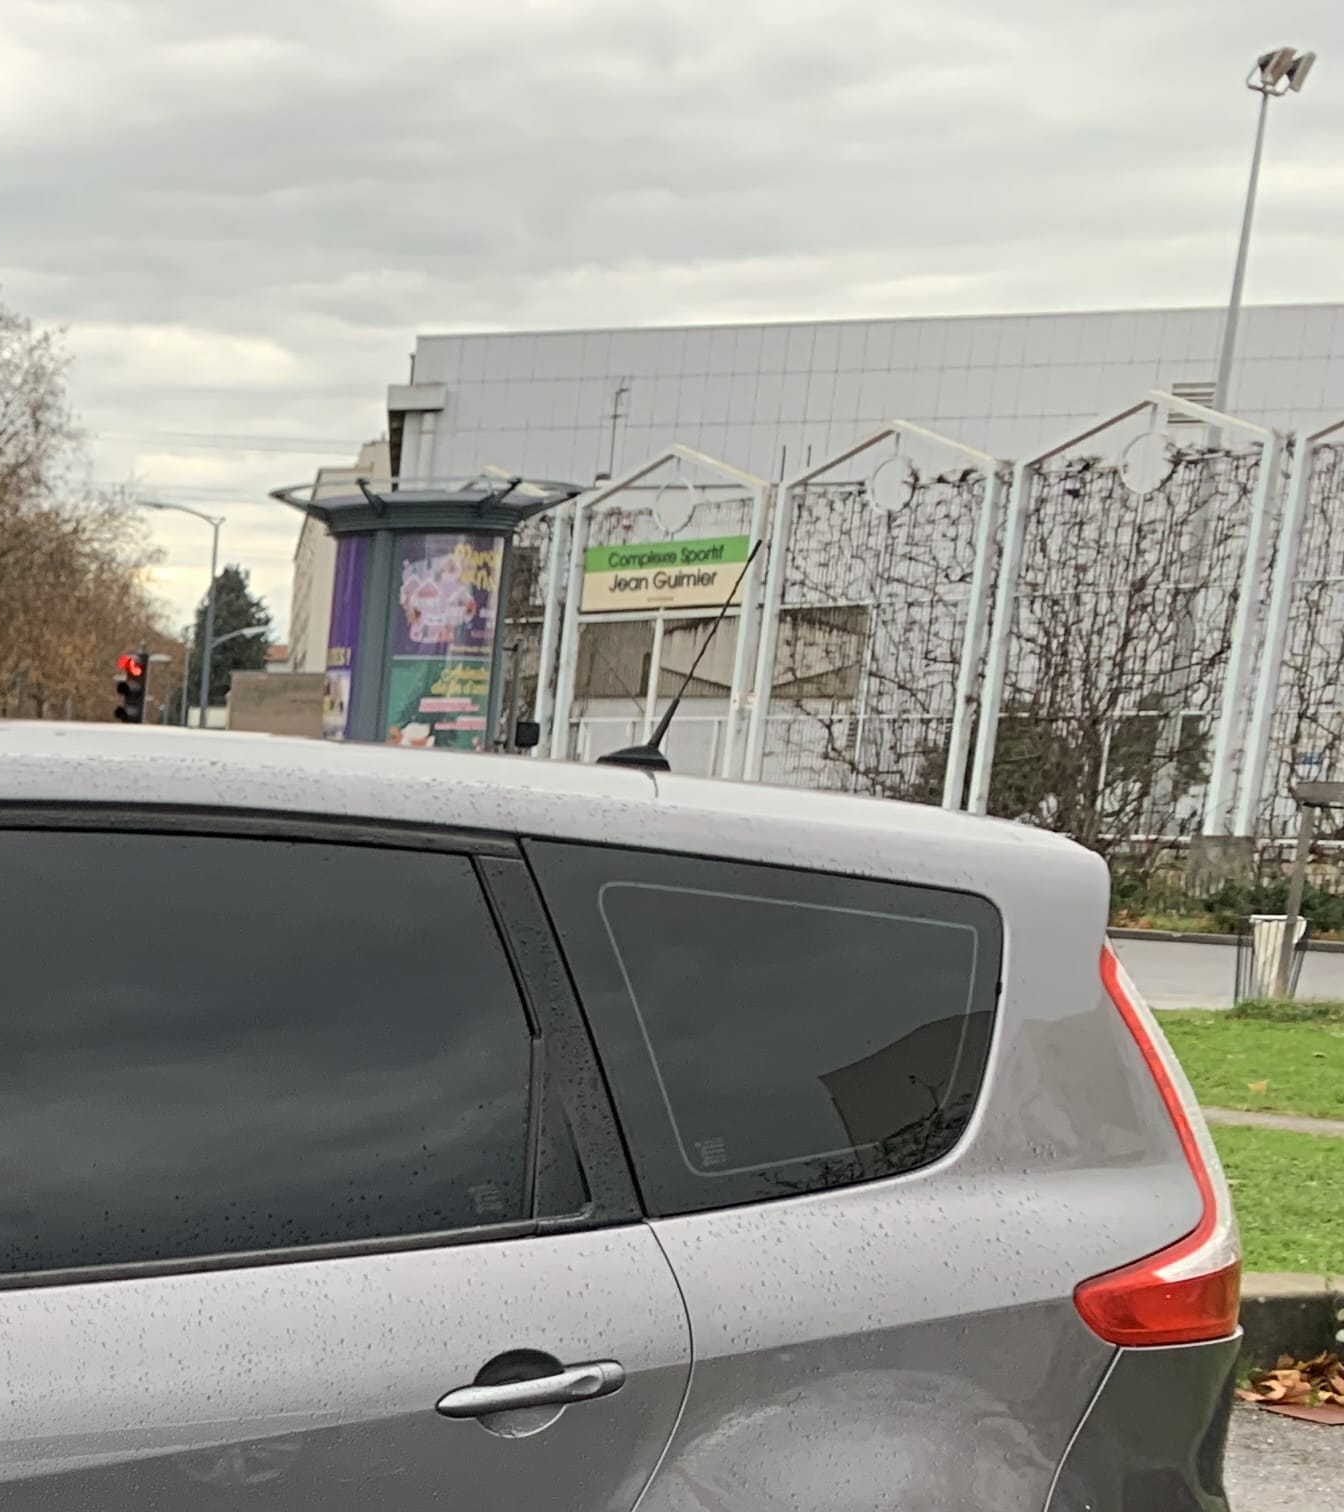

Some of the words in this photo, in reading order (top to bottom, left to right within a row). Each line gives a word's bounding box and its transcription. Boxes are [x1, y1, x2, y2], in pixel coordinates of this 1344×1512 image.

[608, 552, 676, 568] Complexe
[680, 544, 724, 565] Sportif
[609, 573, 648, 592] Jean
[652, 570, 717, 590] Guimier
